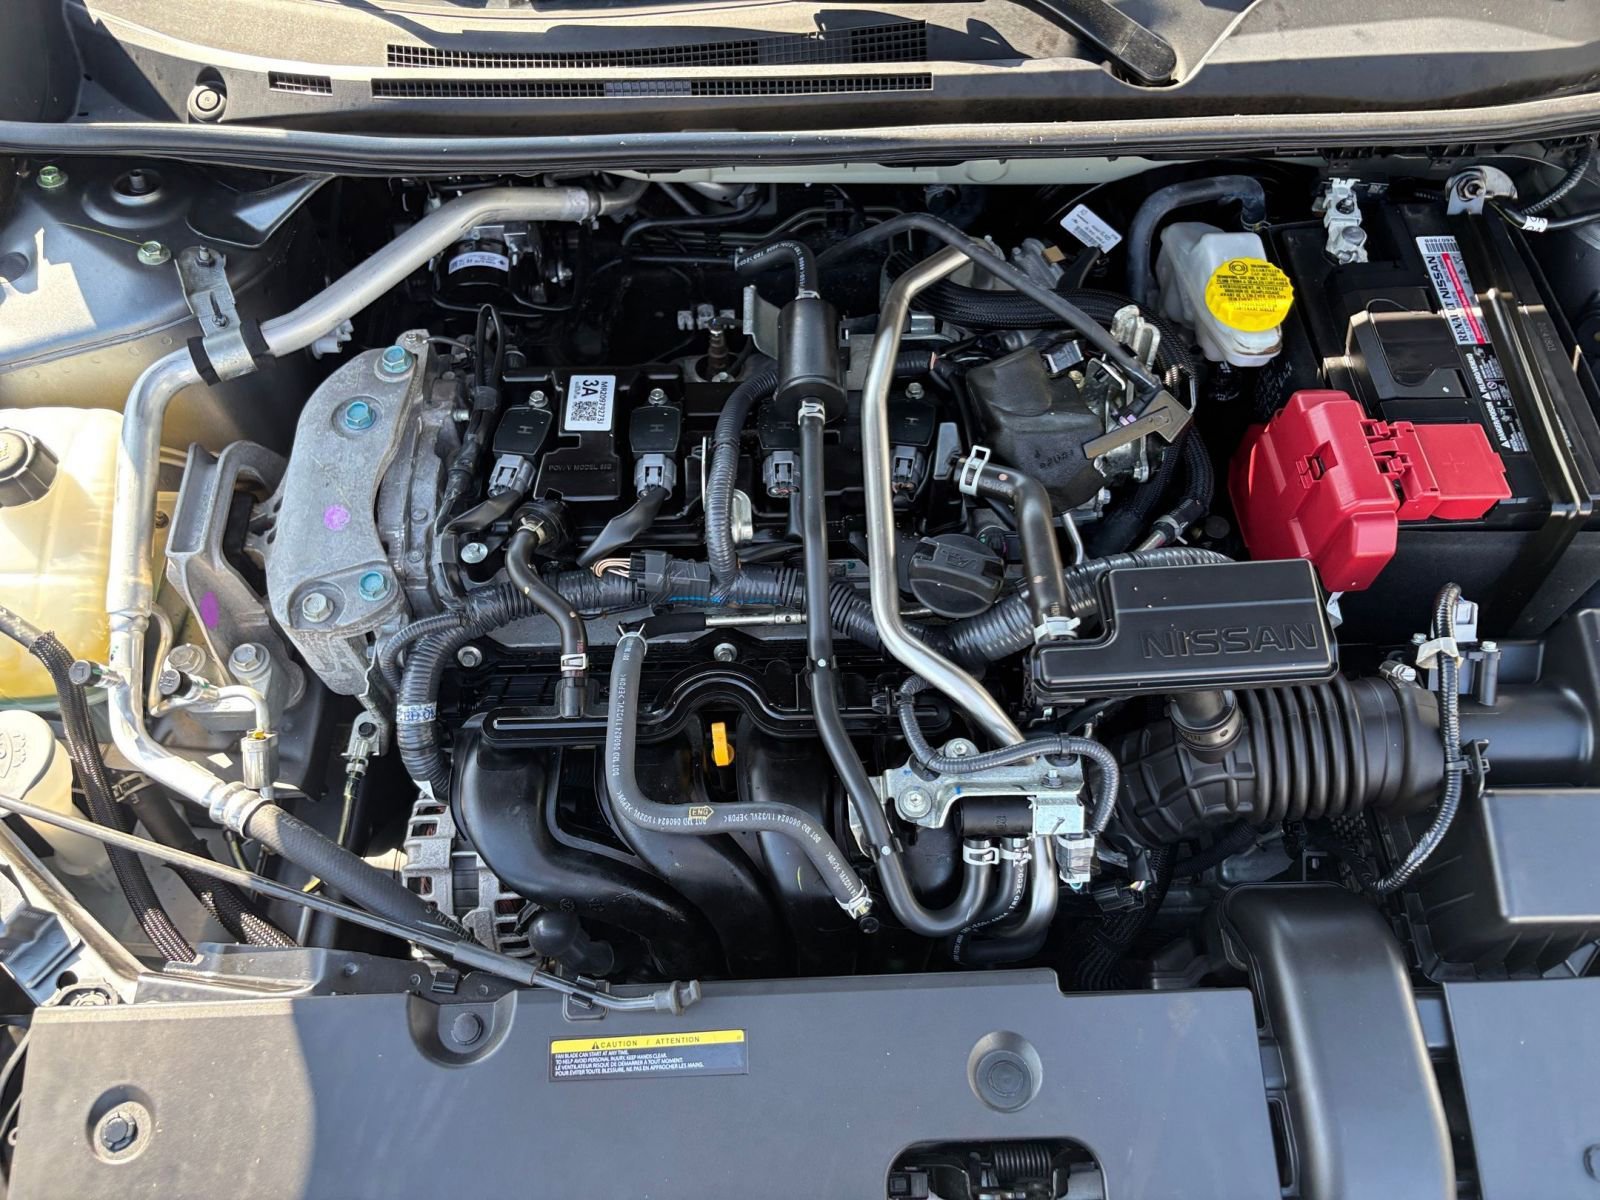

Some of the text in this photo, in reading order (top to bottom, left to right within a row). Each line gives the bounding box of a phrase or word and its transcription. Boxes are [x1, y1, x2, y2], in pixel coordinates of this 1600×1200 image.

[1427, 256, 1451, 299] NISSAN
[581, 380, 600, 397] 3A
[1139, 623, 1318, 658] NISSAN
[692, 808, 709, 816] ENG
[600, 1039, 638, 1049] CAUTION
[655, 1035, 700, 1045] ATTENTION
